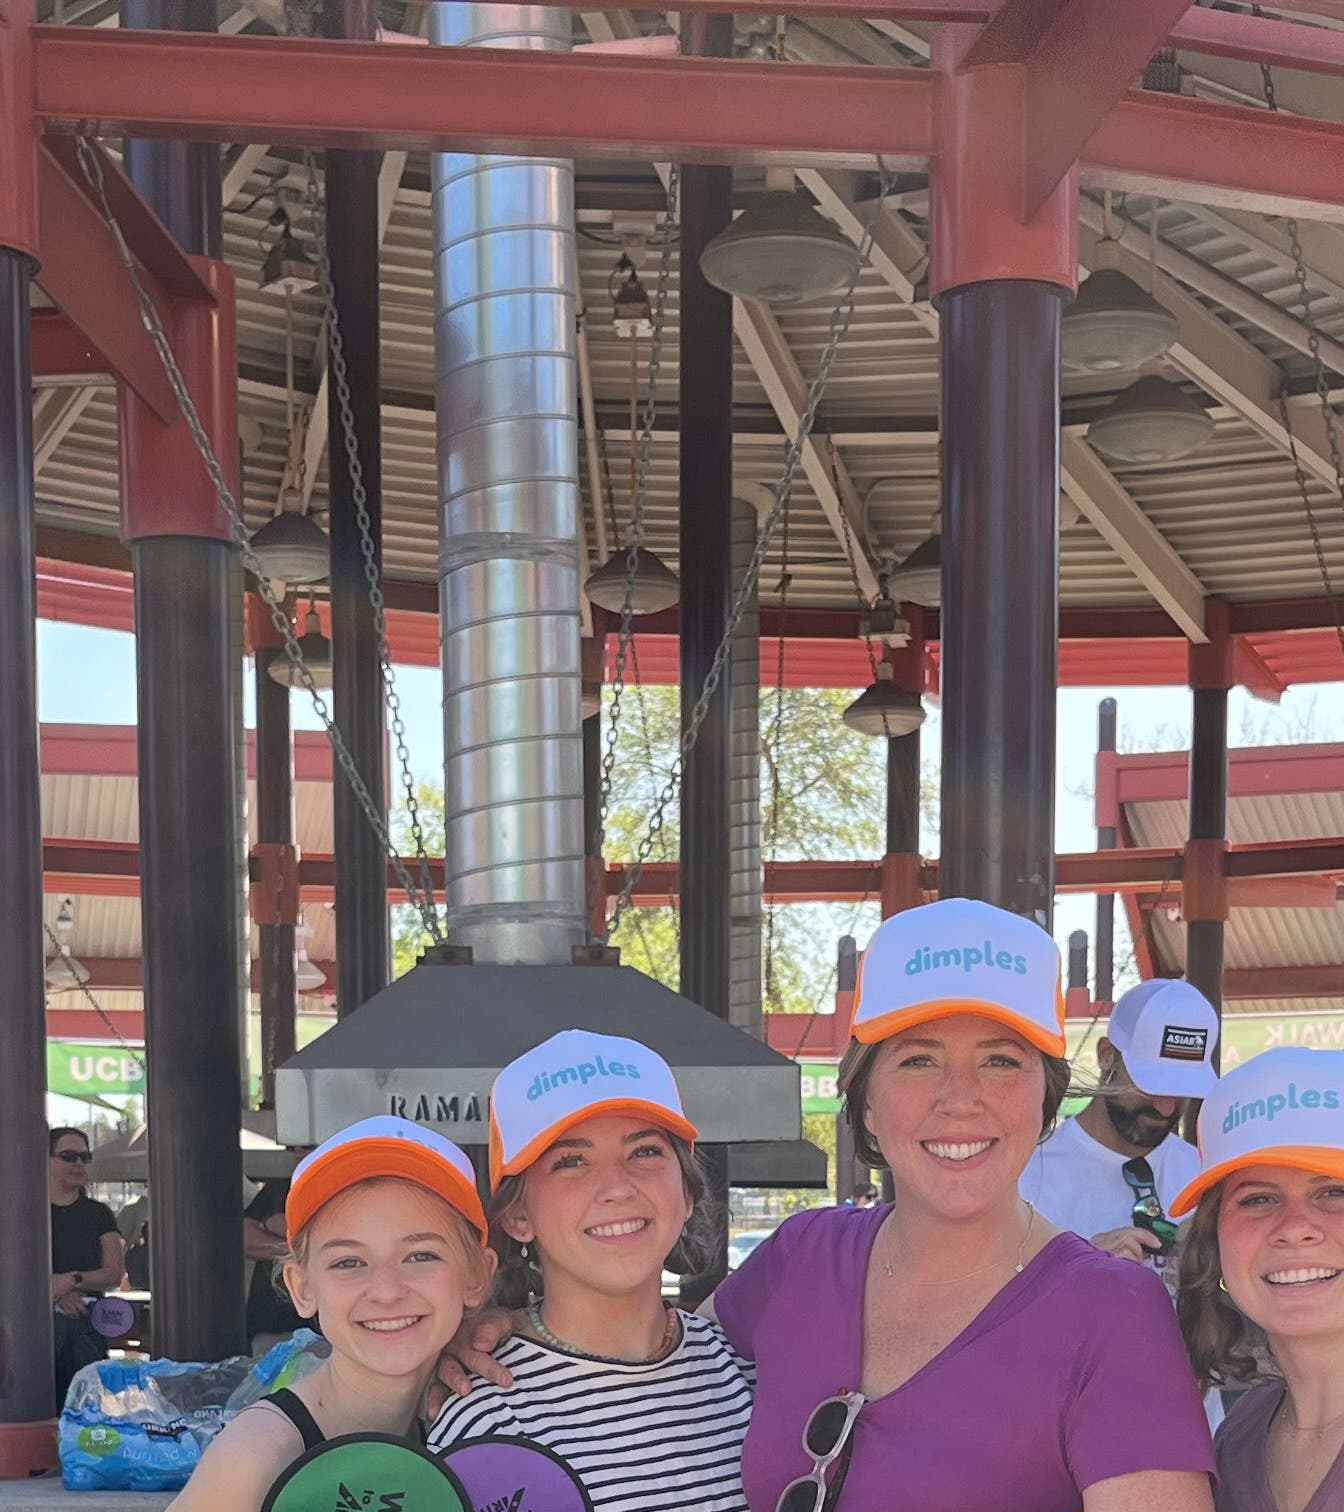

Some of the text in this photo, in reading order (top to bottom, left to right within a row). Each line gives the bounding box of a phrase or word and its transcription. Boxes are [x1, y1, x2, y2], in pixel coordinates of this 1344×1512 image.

[904, 939, 1027, 976] dimples
[526, 1055, 641, 1101] dimples
[390, 1095, 492, 1123] RAMA
[1222, 1082, 1340, 1135] dimples
[361, 1489, 376, 1505] to
